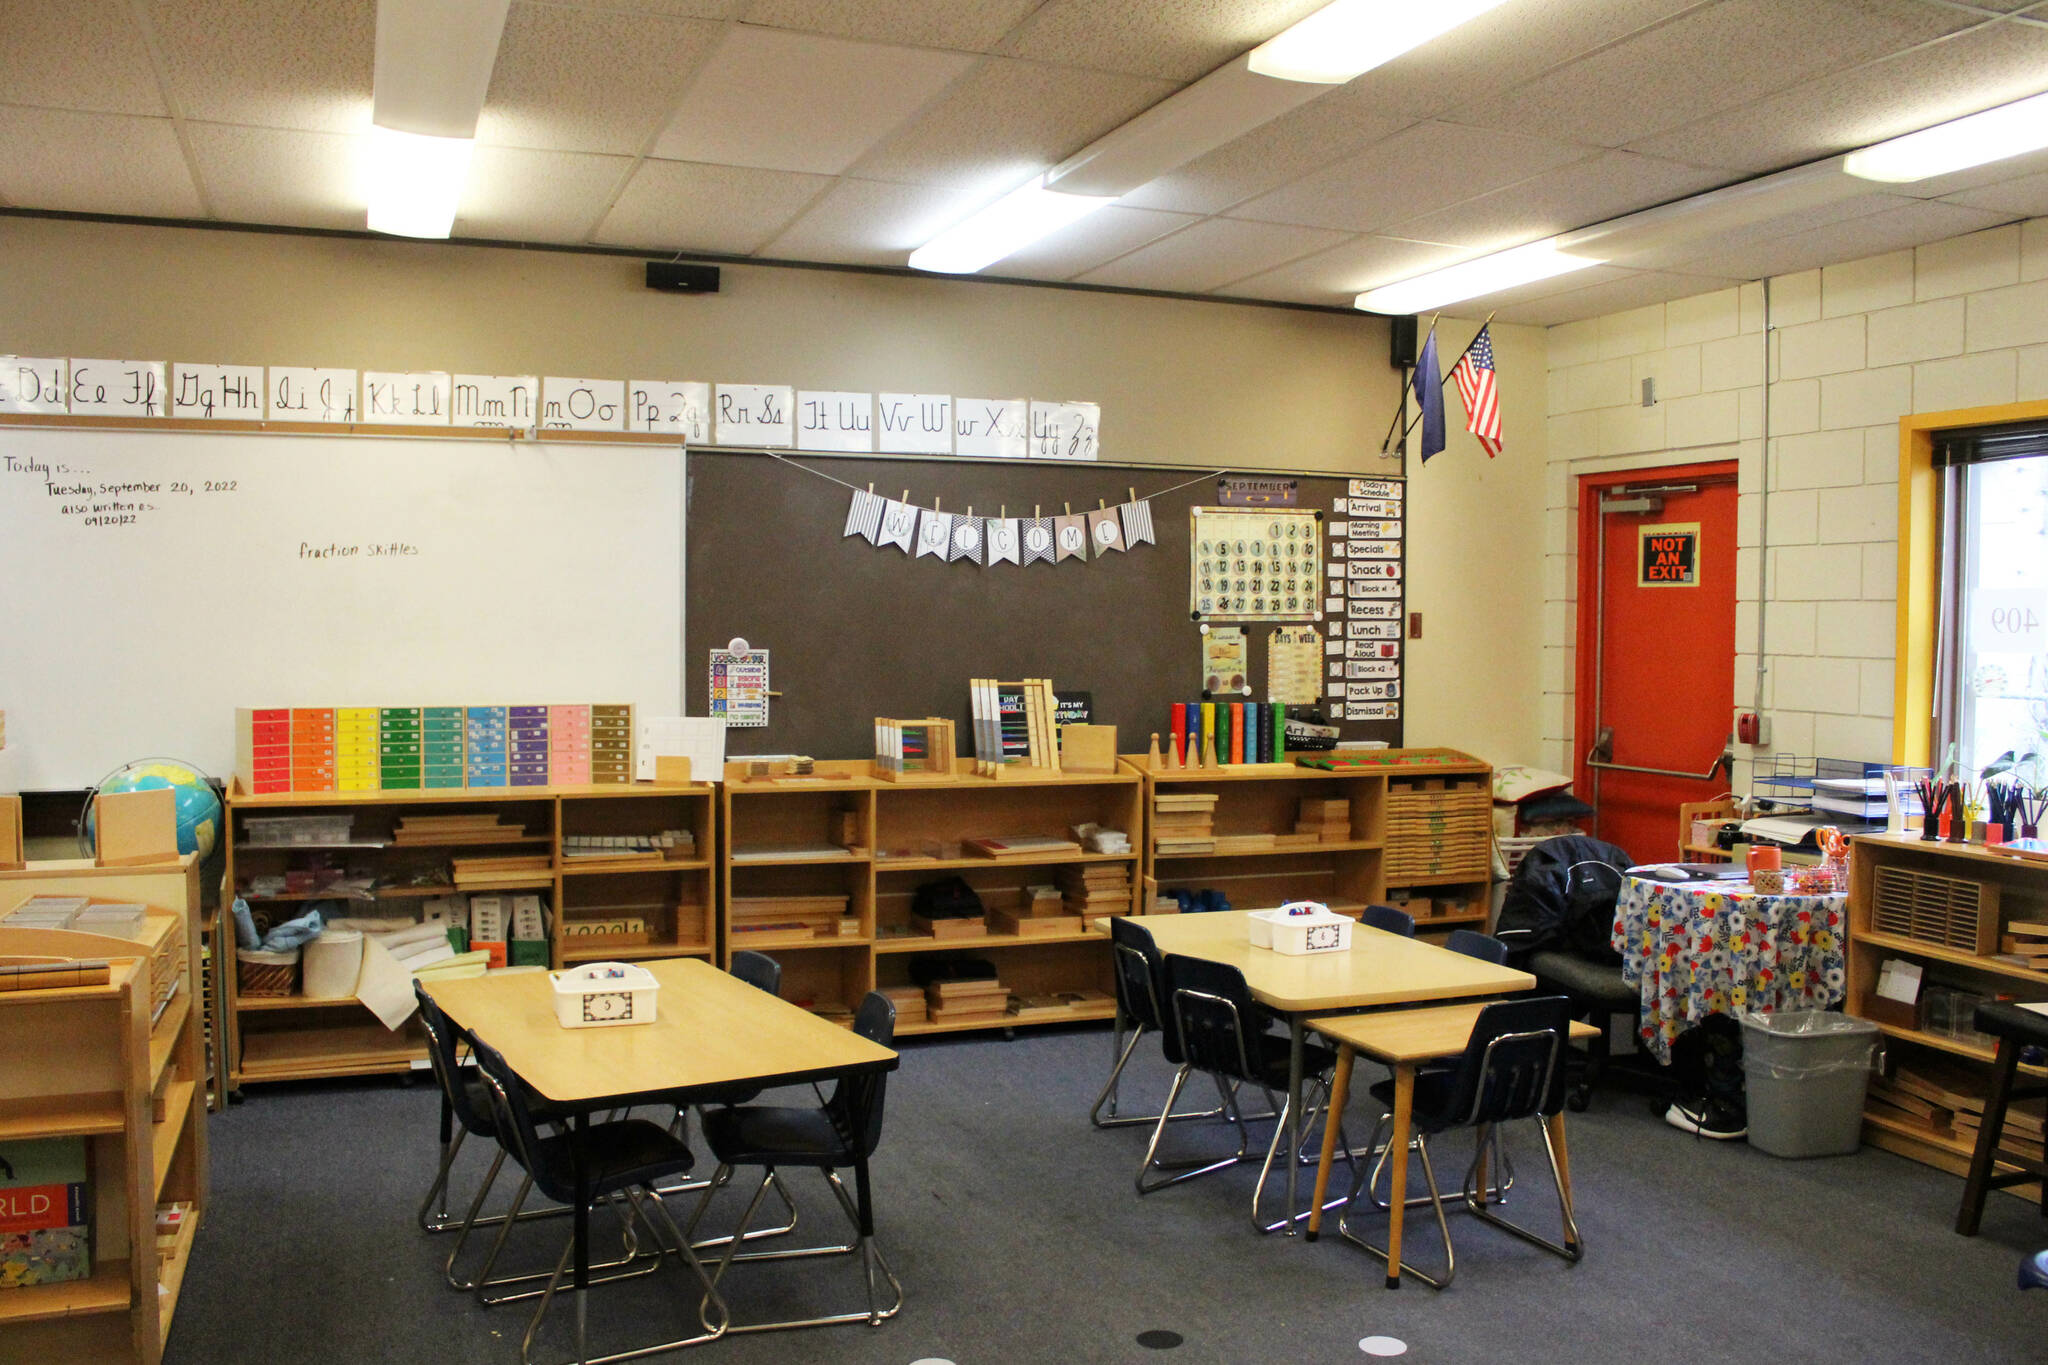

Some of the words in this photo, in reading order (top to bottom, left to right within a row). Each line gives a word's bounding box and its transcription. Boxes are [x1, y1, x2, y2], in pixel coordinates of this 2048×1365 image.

[3, 456, 50, 482] Today
[45, 482, 97, 501] Tuesday,
[99, 481, 161, 497] September
[170, 480, 193, 496] 20,
[204, 480, 238, 492] 2022
[1225, 481, 1290, 491] SEPTEMBER
[1362, 481, 1388, 489] Today's
[1359, 489, 1390, 497] Schedule
[61, 503, 88, 515] also
[93, 501, 134, 513] written
[1351, 503, 1382, 512] Arrival
[1351, 521, 1380, 529] Morning
[299, 541, 360, 559] fraction
[1304, 543, 1313, 554] 10
[1349, 544, 1384, 555] Specials
[1651, 538, 1687, 552] NOT
[1655, 552, 1680, 565] AN
[1203, 562, 1210, 573] 11
[1219, 561, 1226, 572] 12
[1236, 560, 1245, 572] 13
[1254, 562, 1262, 573] 14
[1272, 561, 1280, 572] 15
[1288, 562, 1296, 572] 16
[1304, 562, 1313, 573] 17
[1352, 565, 1382, 575] Snack
[1648, 566, 1688, 579] EXIT
[1202, 579, 1211, 590] 18
[1220, 579, 1228, 591] 19
[1236, 580, 1245, 591] 20
[1252, 580, 1261, 591] 21
[1270, 580, 1280, 591] 22
[1287, 580, 1295, 591] 23
[1202, 600, 1210, 610] 25
[1219, 597, 1229, 610] 26
[1235, 598, 1245, 609] 27
[1271, 600, 1280, 611] 29
[1287, 597, 1297, 609] 30
[1306, 599, 1314, 610] 31
[1350, 604, 1384, 615] Recess
[1352, 625, 1381, 635] Lunch
[1275, 634, 1291, 643] DAYS
[1299, 634, 1316, 643] WEEK
[1355, 641, 1374, 649] Read
[1354, 649, 1376, 657] Aloud
[1358, 665, 1375, 673] Block
[1349, 686, 1370, 695] Pack
[1372, 686, 1383, 696] Up
[1000, 704, 1024, 712] HOOL!
[1073, 701, 1084, 709] MY
[1346, 706, 1384, 716] Dismissal
[1286, 725, 1304, 736] Art
[604, 999, 611, 1011] 5
[0, 1194, 50, 1218] RLD
